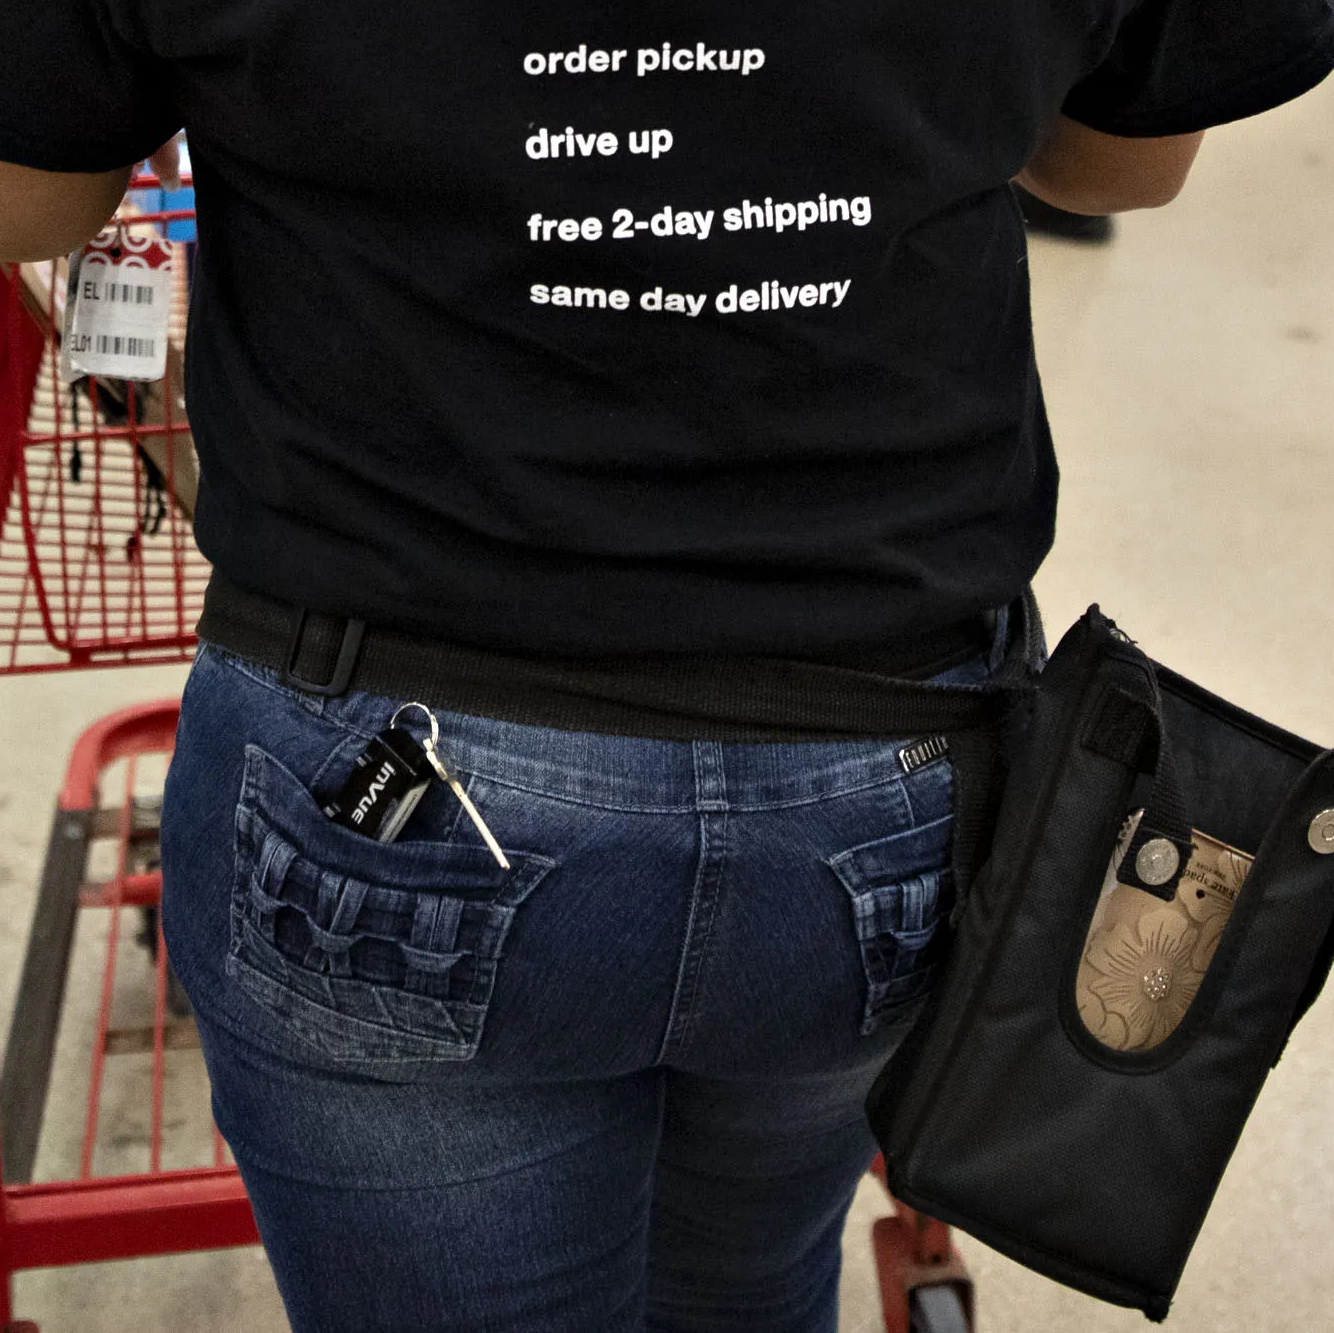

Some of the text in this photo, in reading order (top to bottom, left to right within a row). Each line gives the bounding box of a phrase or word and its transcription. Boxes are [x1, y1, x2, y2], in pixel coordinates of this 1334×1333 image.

[524, 42, 765, 76] order pickup
[525, 127, 673, 159] drive up
[527, 193, 872, 241] free 2-day shipping
[83, 282, 100, 300] EL
[530, 279, 852, 317] same day delivery
[1184, 869, 1211, 885] spac
